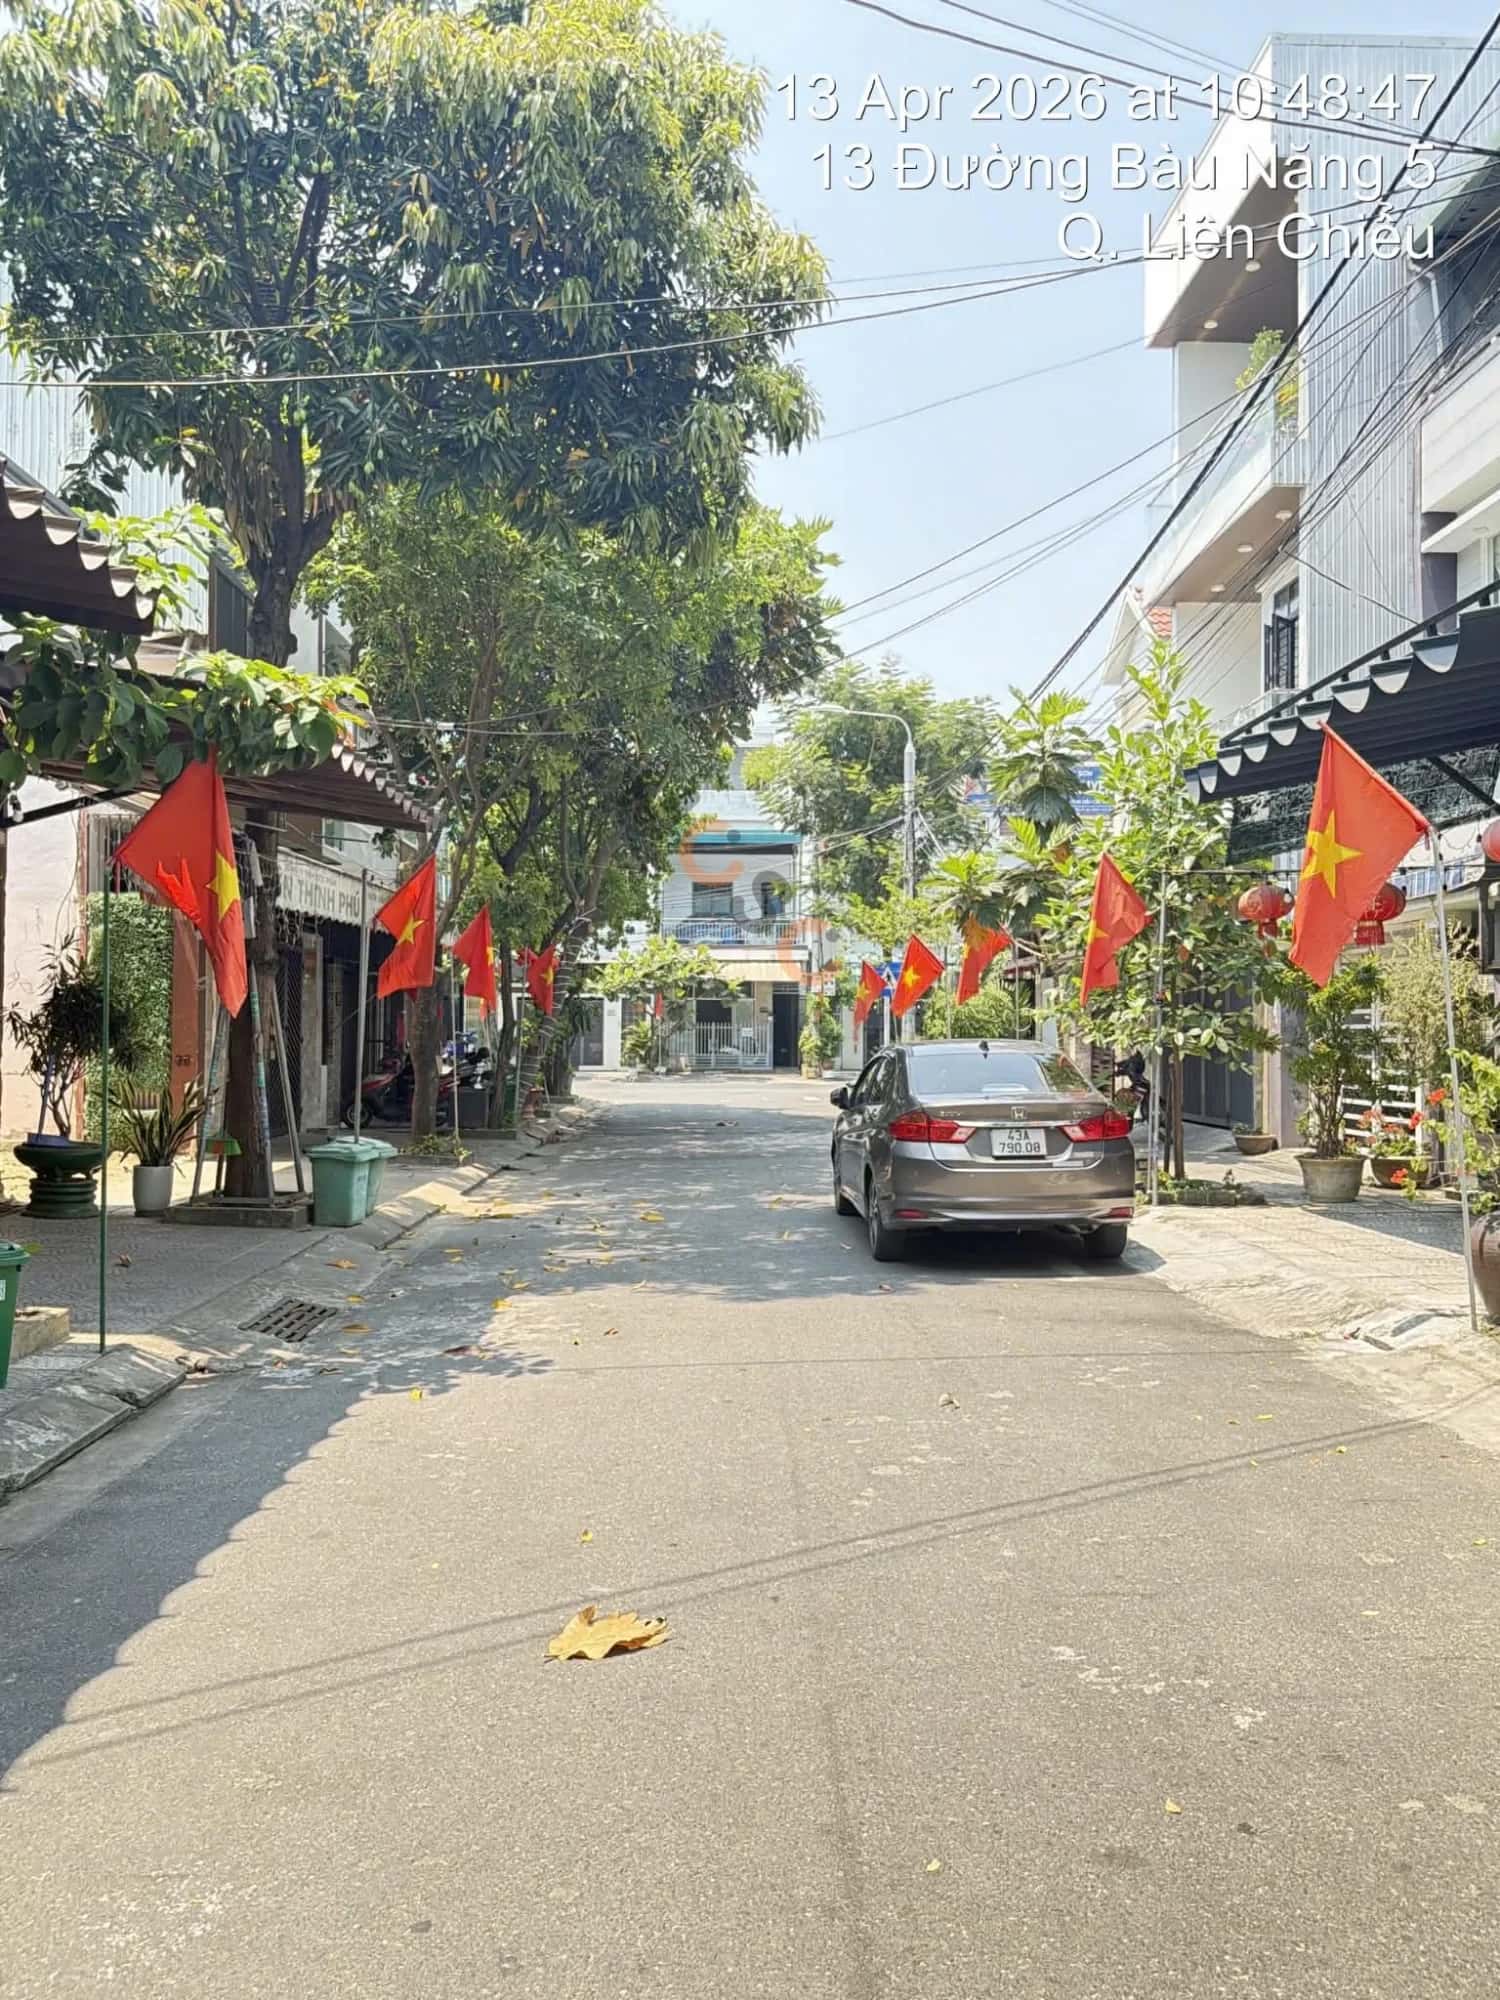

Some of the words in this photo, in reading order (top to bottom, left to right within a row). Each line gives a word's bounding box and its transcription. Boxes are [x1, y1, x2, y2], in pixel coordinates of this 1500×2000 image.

[338, 890, 361, 918] PHÚ
[1007, 1129, 1031, 1141] 43A
[999, 1142, 1041, 1154] 790.08
